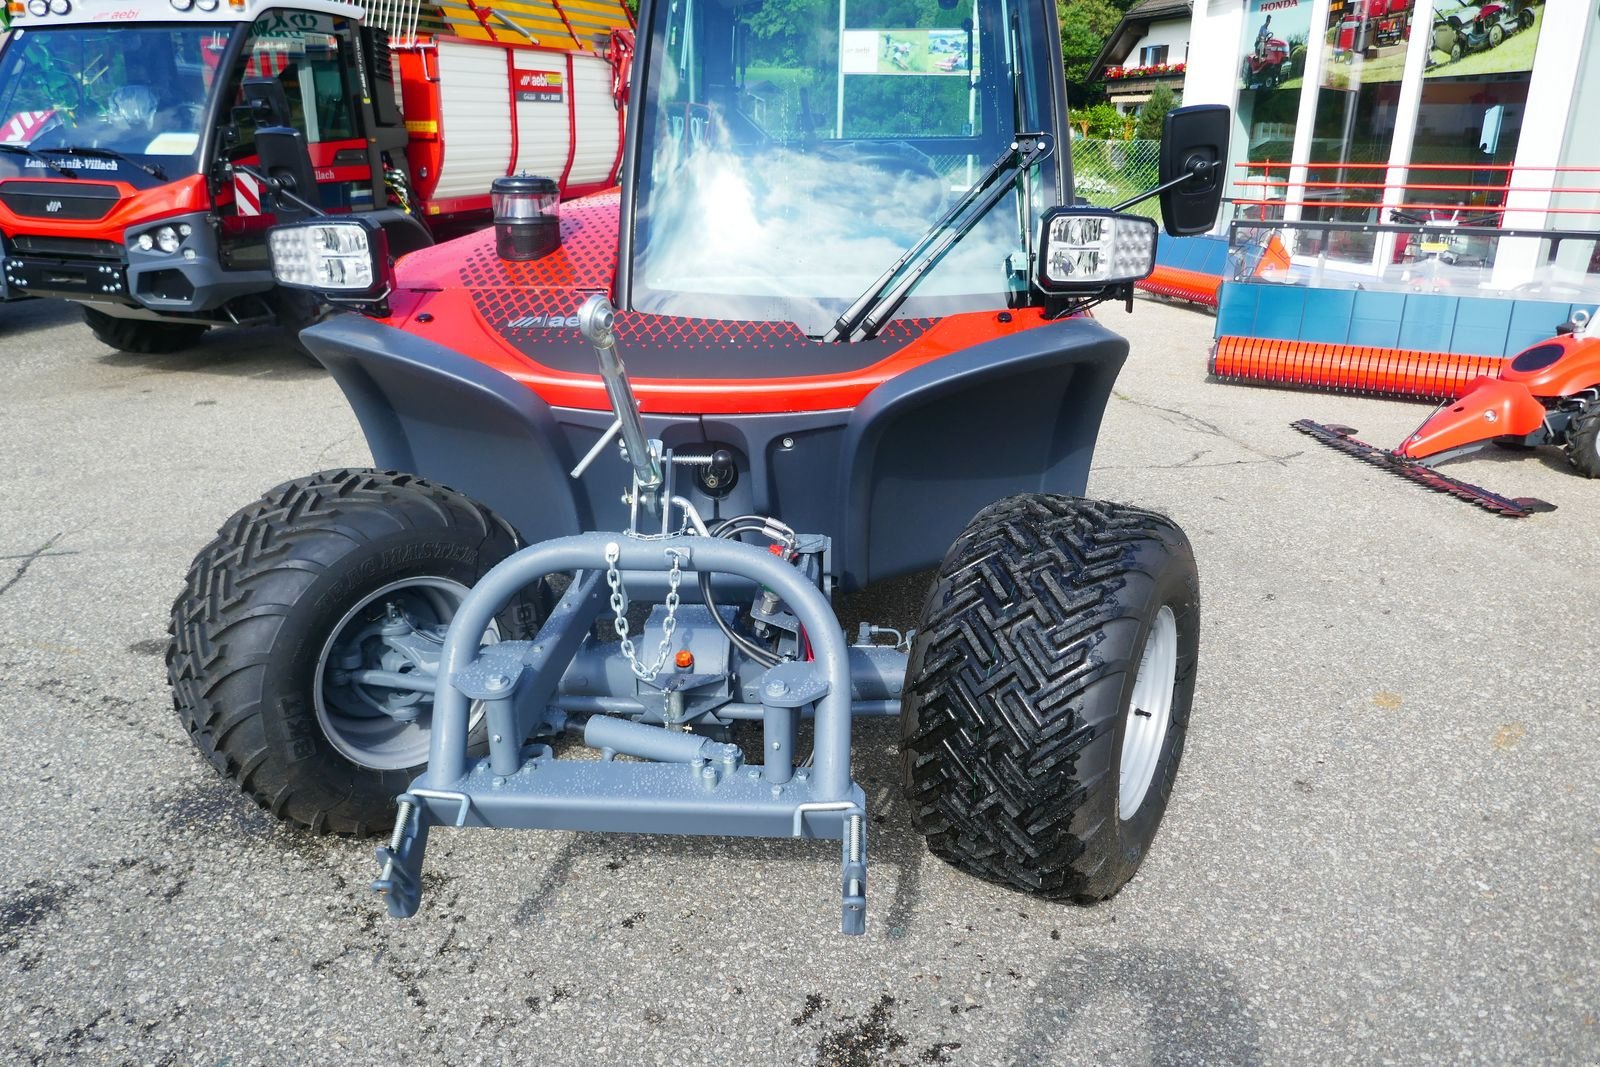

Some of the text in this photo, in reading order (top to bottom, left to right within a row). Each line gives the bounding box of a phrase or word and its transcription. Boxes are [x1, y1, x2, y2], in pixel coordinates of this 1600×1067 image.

[1260, 0, 1298, 12] HONDA
[111, 9, 139, 20] aebi
[25, 158, 119, 171] Lanchnik-Villach
[381, 540, 479, 571] MASTER
